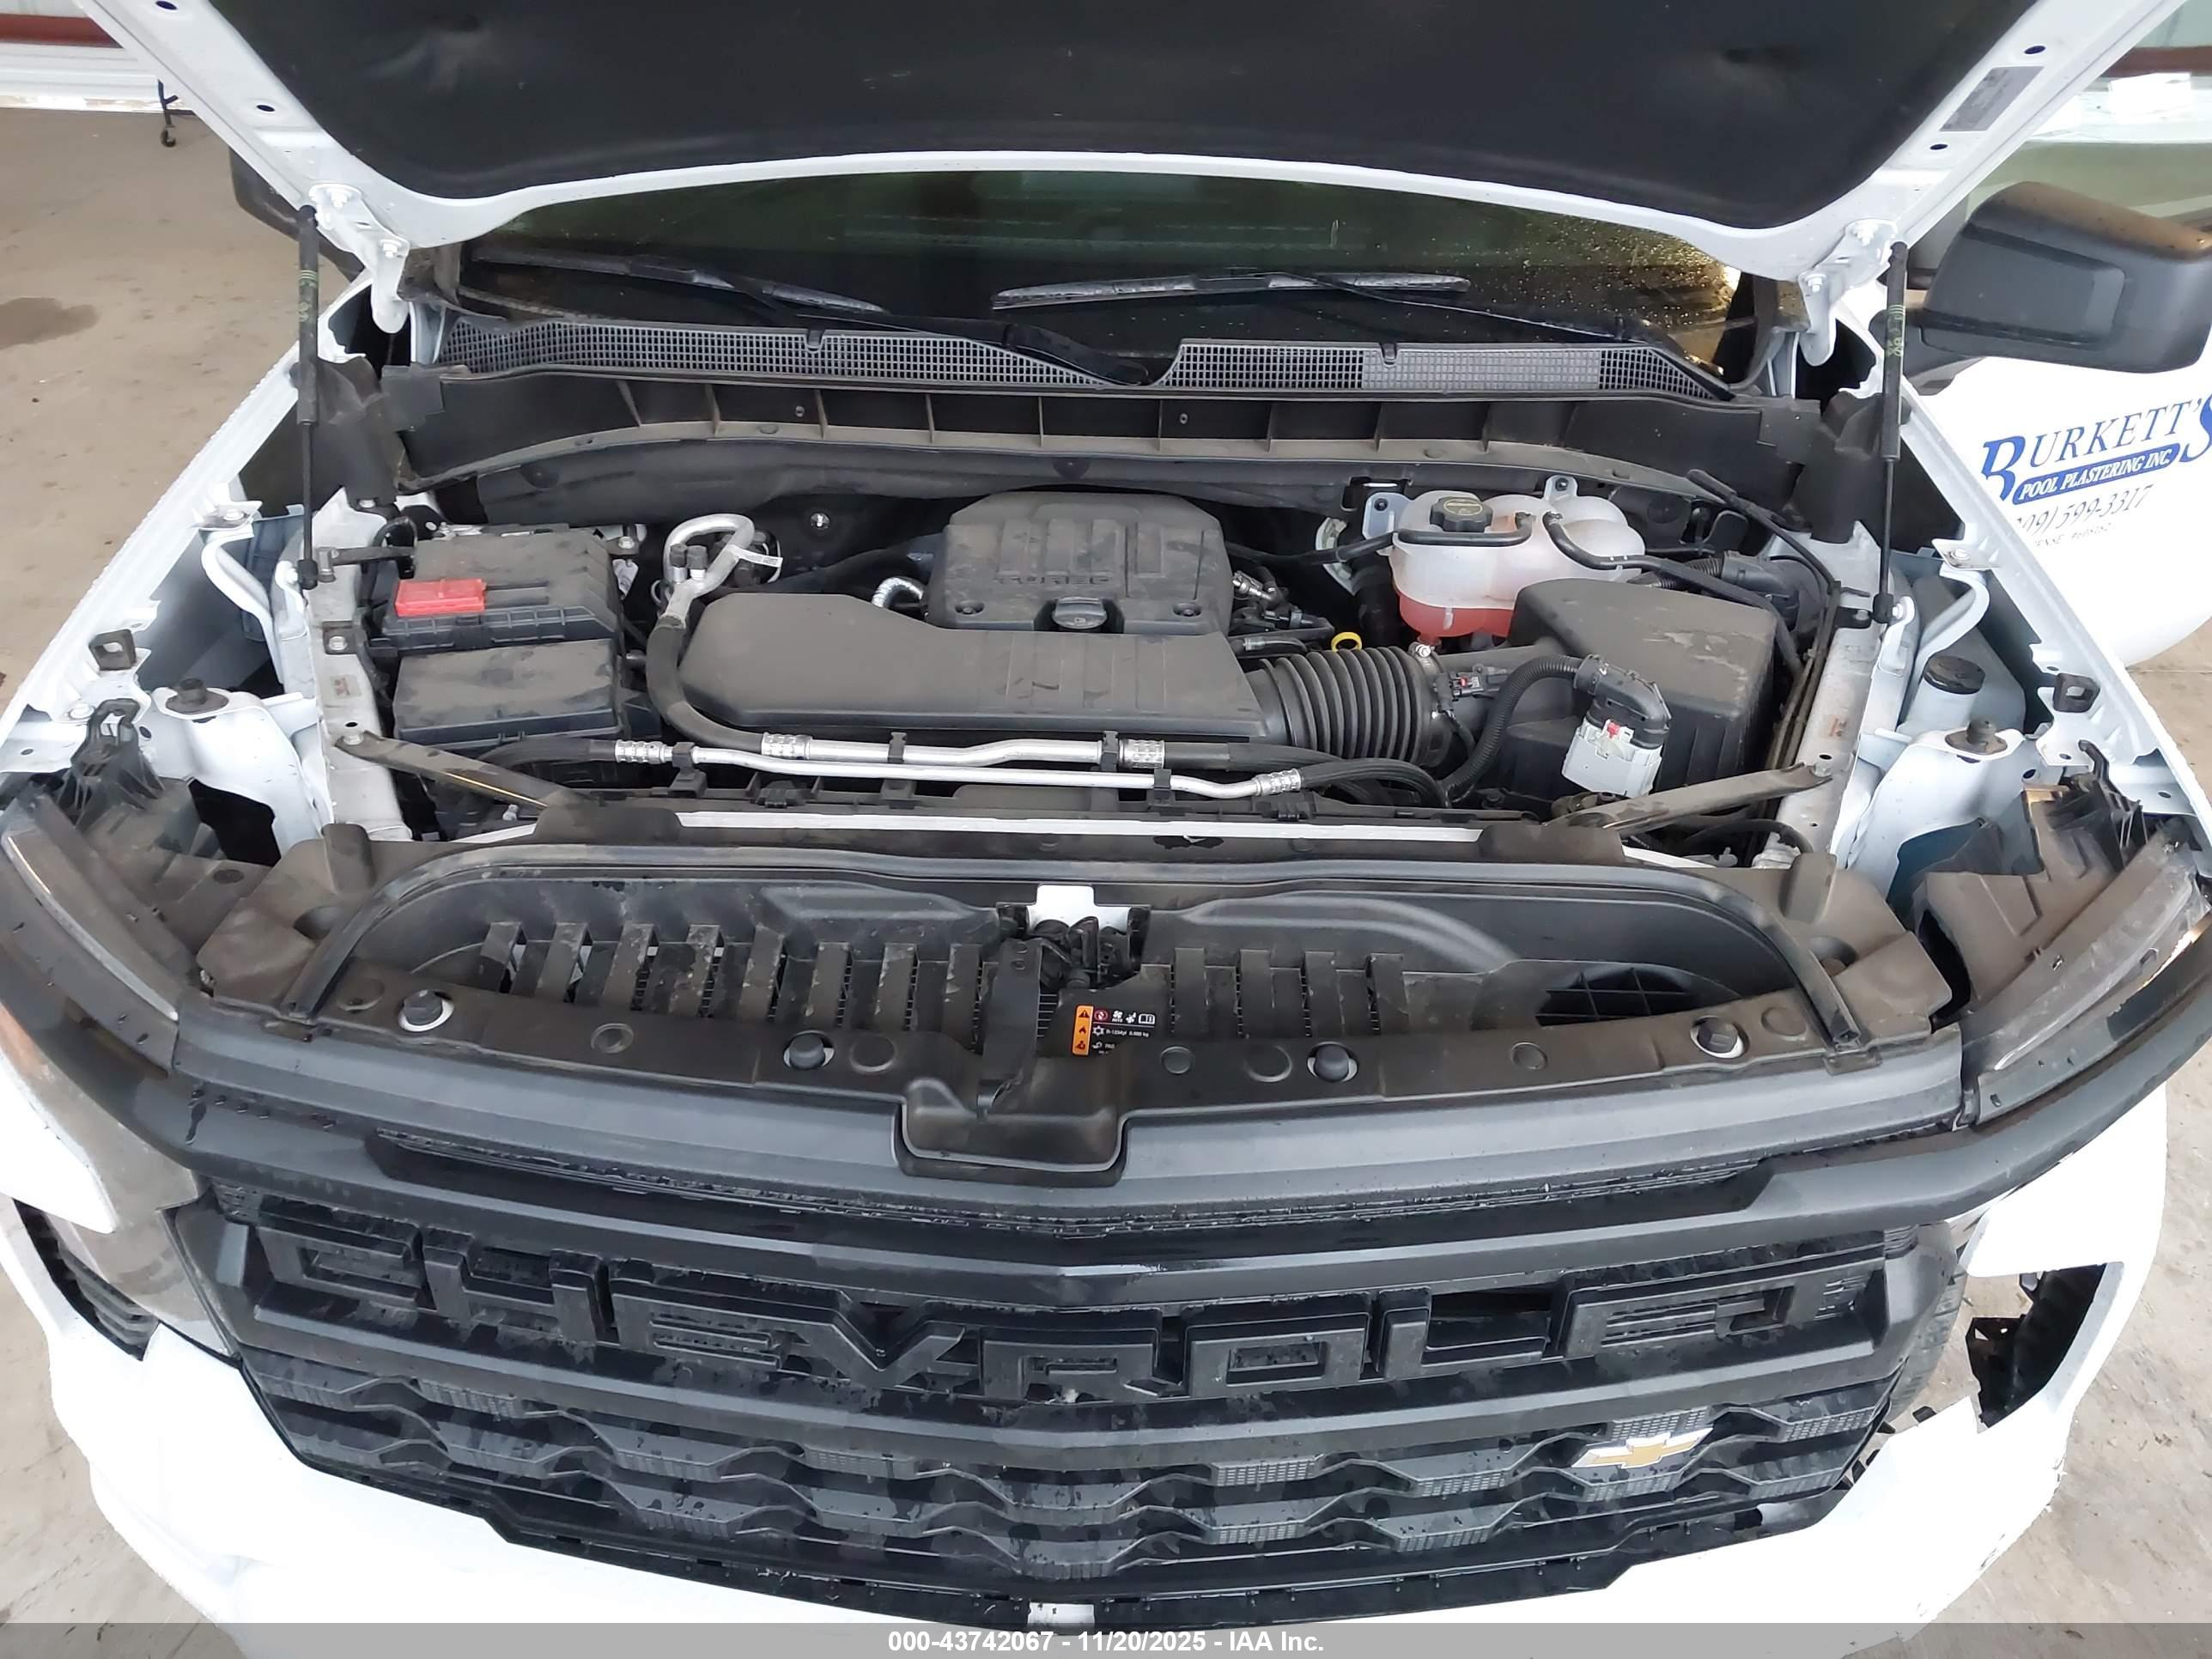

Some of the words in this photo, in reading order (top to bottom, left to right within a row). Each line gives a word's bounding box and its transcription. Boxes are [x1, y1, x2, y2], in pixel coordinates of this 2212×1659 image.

[1980, 393, 2212, 501] BURKETT'S
[2018, 476, 2059, 500] POOL
[2059, 453, 2147, 491] PLASTERING
[2055, 483, 2154, 529] 599-3317
[256, 1224, 1886, 1406] CHEVROLET
